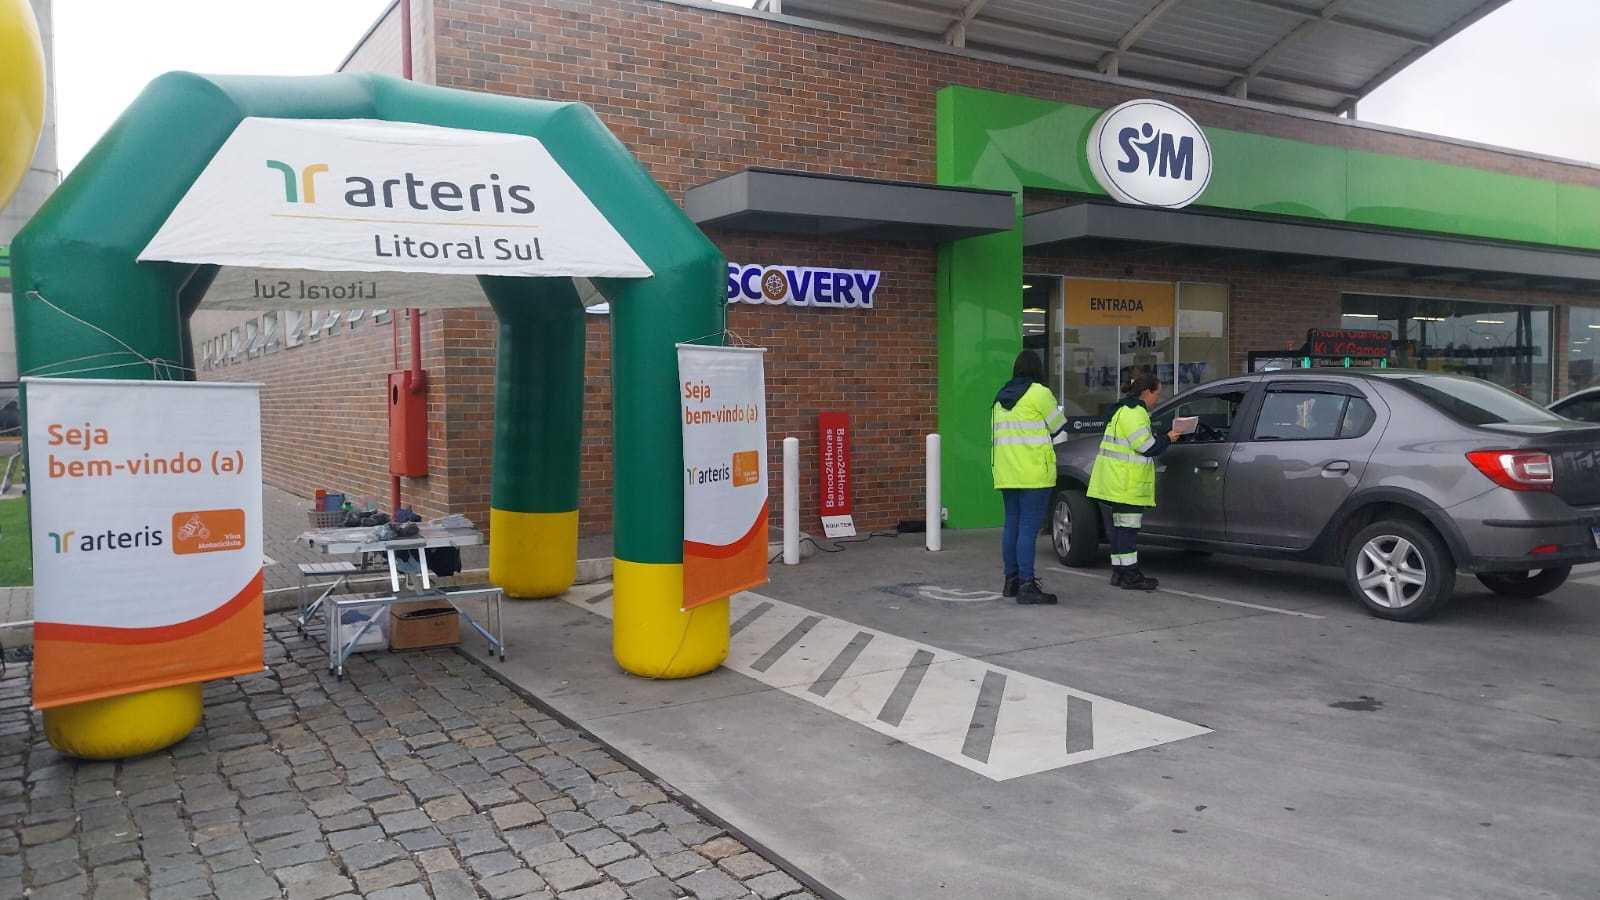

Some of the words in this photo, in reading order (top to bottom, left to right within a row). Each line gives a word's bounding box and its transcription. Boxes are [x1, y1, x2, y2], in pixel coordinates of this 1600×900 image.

[1117, 123, 1194, 181] SIM
[344, 172, 536, 215] arteris
[374, 234, 485, 260] Litoral
[494, 237, 544, 261] Sul
[728, 265, 877, 305] SCOVERY
[1090, 297, 1144, 312] ENTRADA
[684, 380, 711, 403] Seja
[685, 404, 744, 425] bem-vindo
[746, 403, 759, 424] (a)
[47, 422, 109, 451] Seja
[49, 451, 202, 479] bem-vindo
[211, 450, 245, 476] (a)
[698, 463, 730, 485] arteris
[825, 427, 835, 508] Banco24Horas
[836, 427, 846, 507] Banco24Horas
[80, 525, 163, 552] arteris
